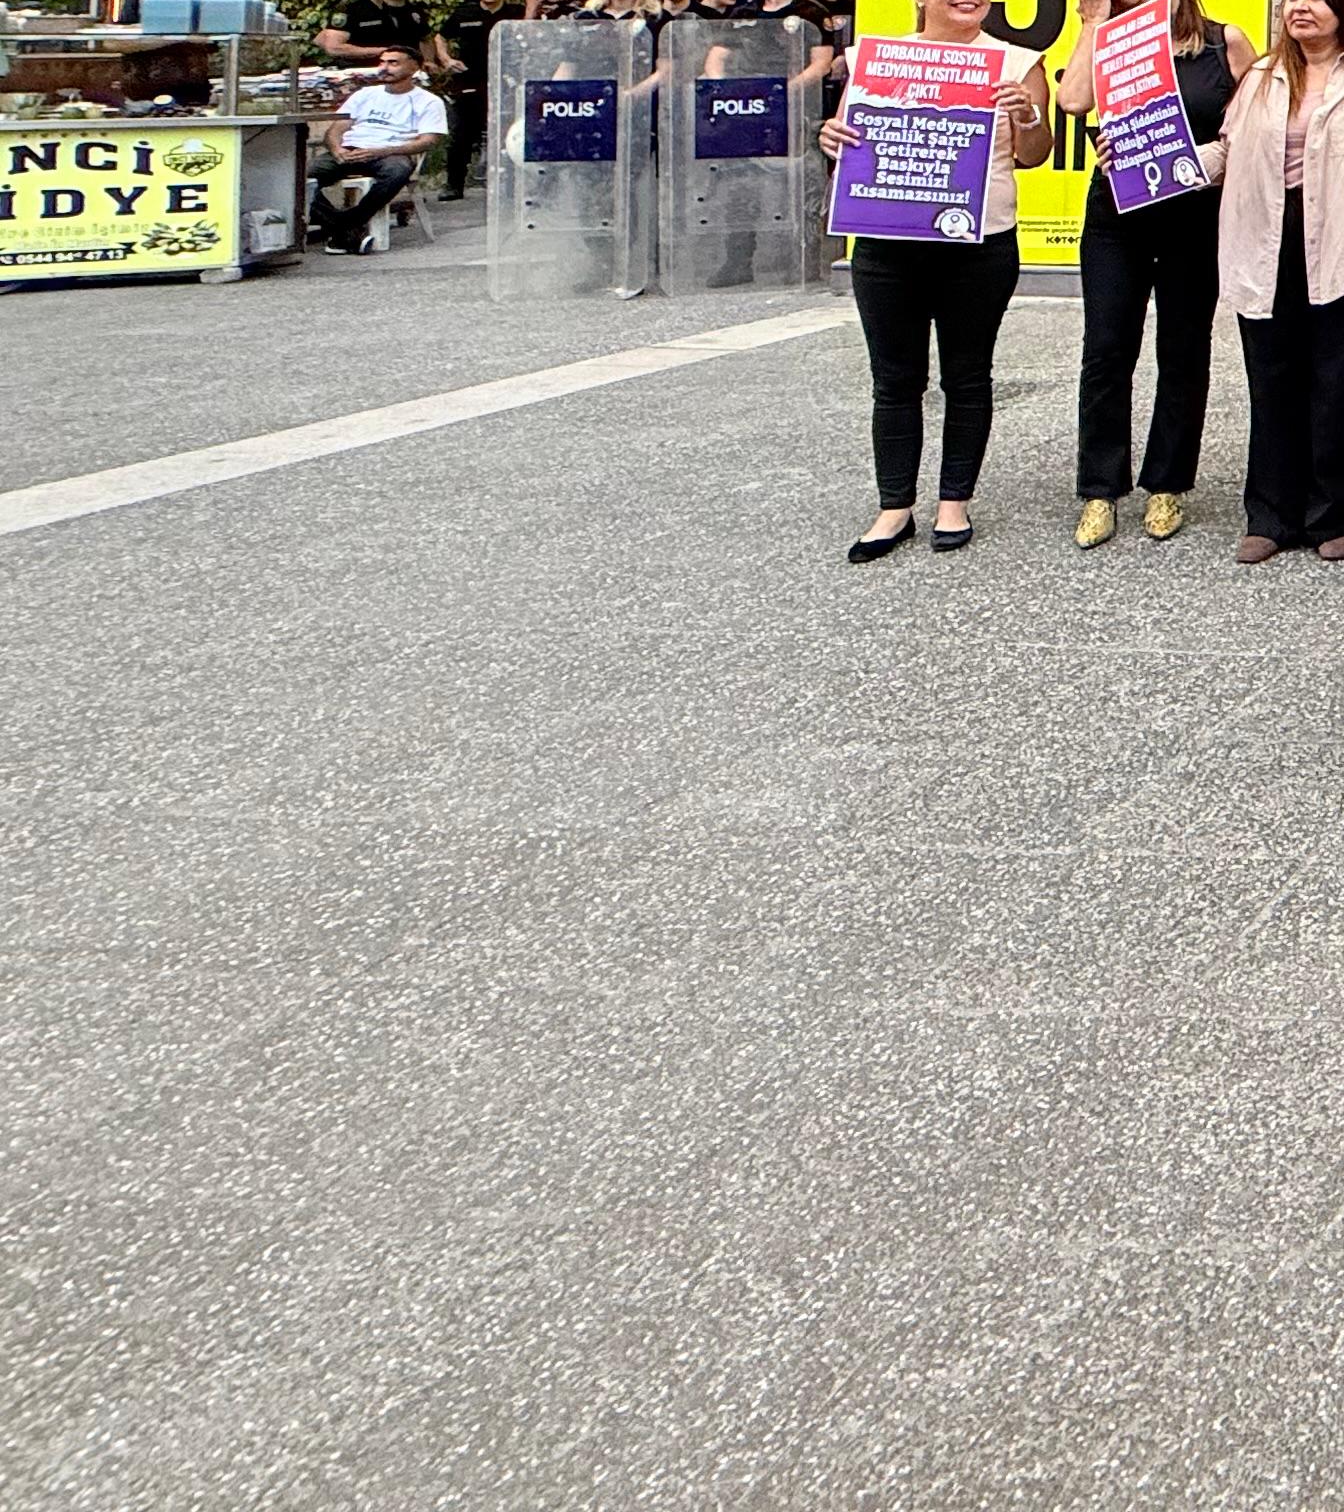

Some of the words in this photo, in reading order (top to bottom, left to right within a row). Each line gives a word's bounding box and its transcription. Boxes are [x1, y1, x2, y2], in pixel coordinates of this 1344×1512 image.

[875, 44, 941, 64] TORBADAN
[942, 47, 988, 67] SOSYAL
[865, 62, 923, 82] MEDYAYA
[924, 68, 990, 87] KISITLAMA
[853, 111, 908, 131] Sosyal
[910, 118, 986, 136] Medyaya
[1130, 104, 1179, 133] Şiddetinin
[865, 127, 925, 146] Kimlik
[927, 131, 970, 149] Şartı
[1114, 134, 1149, 154] Olduğu
[1147, 123, 1177, 141] Yerde
[875, 143, 958, 161] Getirerek
[1113, 150, 1154, 172] Uzlaşma
[876, 158, 951, 176] Baskıyla
[875, 172, 949, 189] Sesimizi
[849, 184, 971, 205] Kısamazsınız!
